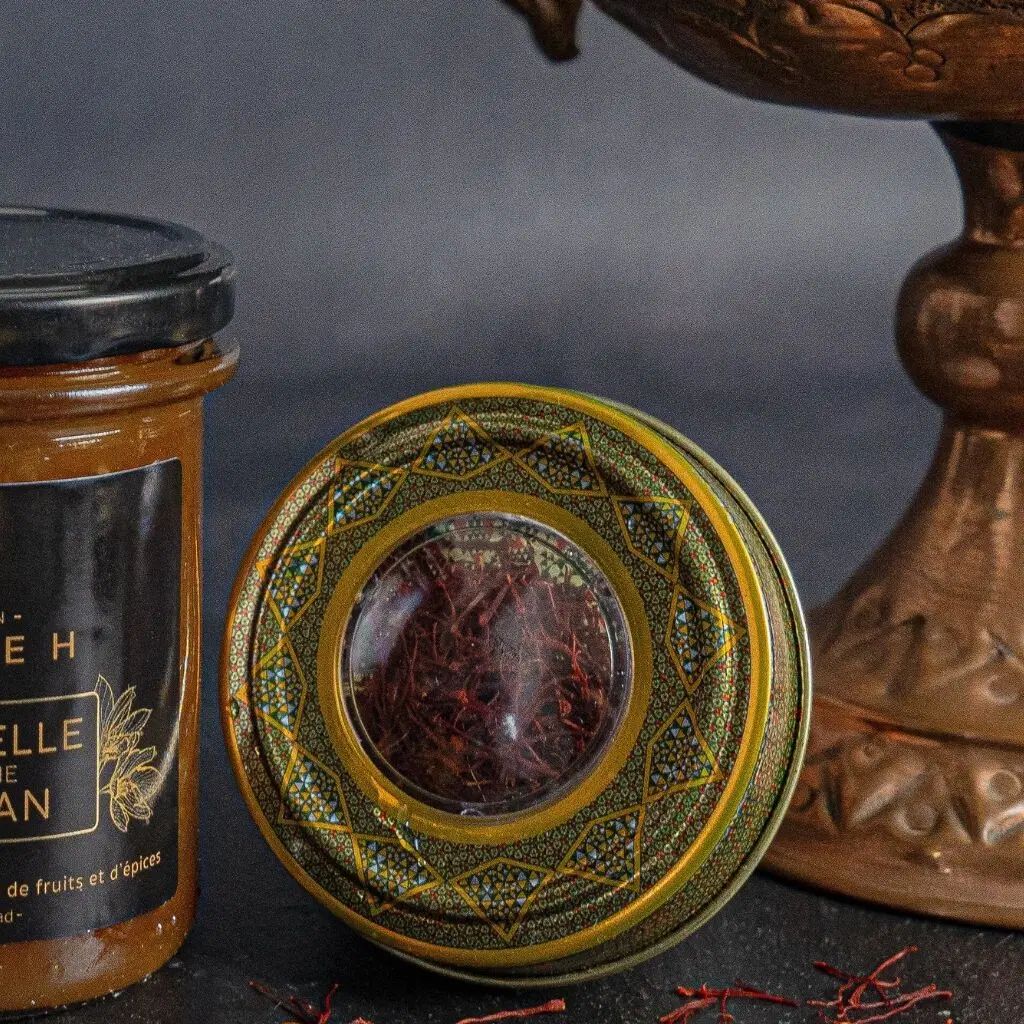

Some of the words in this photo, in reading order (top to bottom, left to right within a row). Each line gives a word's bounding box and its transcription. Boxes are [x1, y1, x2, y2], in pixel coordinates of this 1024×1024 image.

[7, 880, 29, 898] de
[35, 875, 84, 896] fruits
[89, 869, 105, 886] et
[109, 850, 162, 881] d'épices
